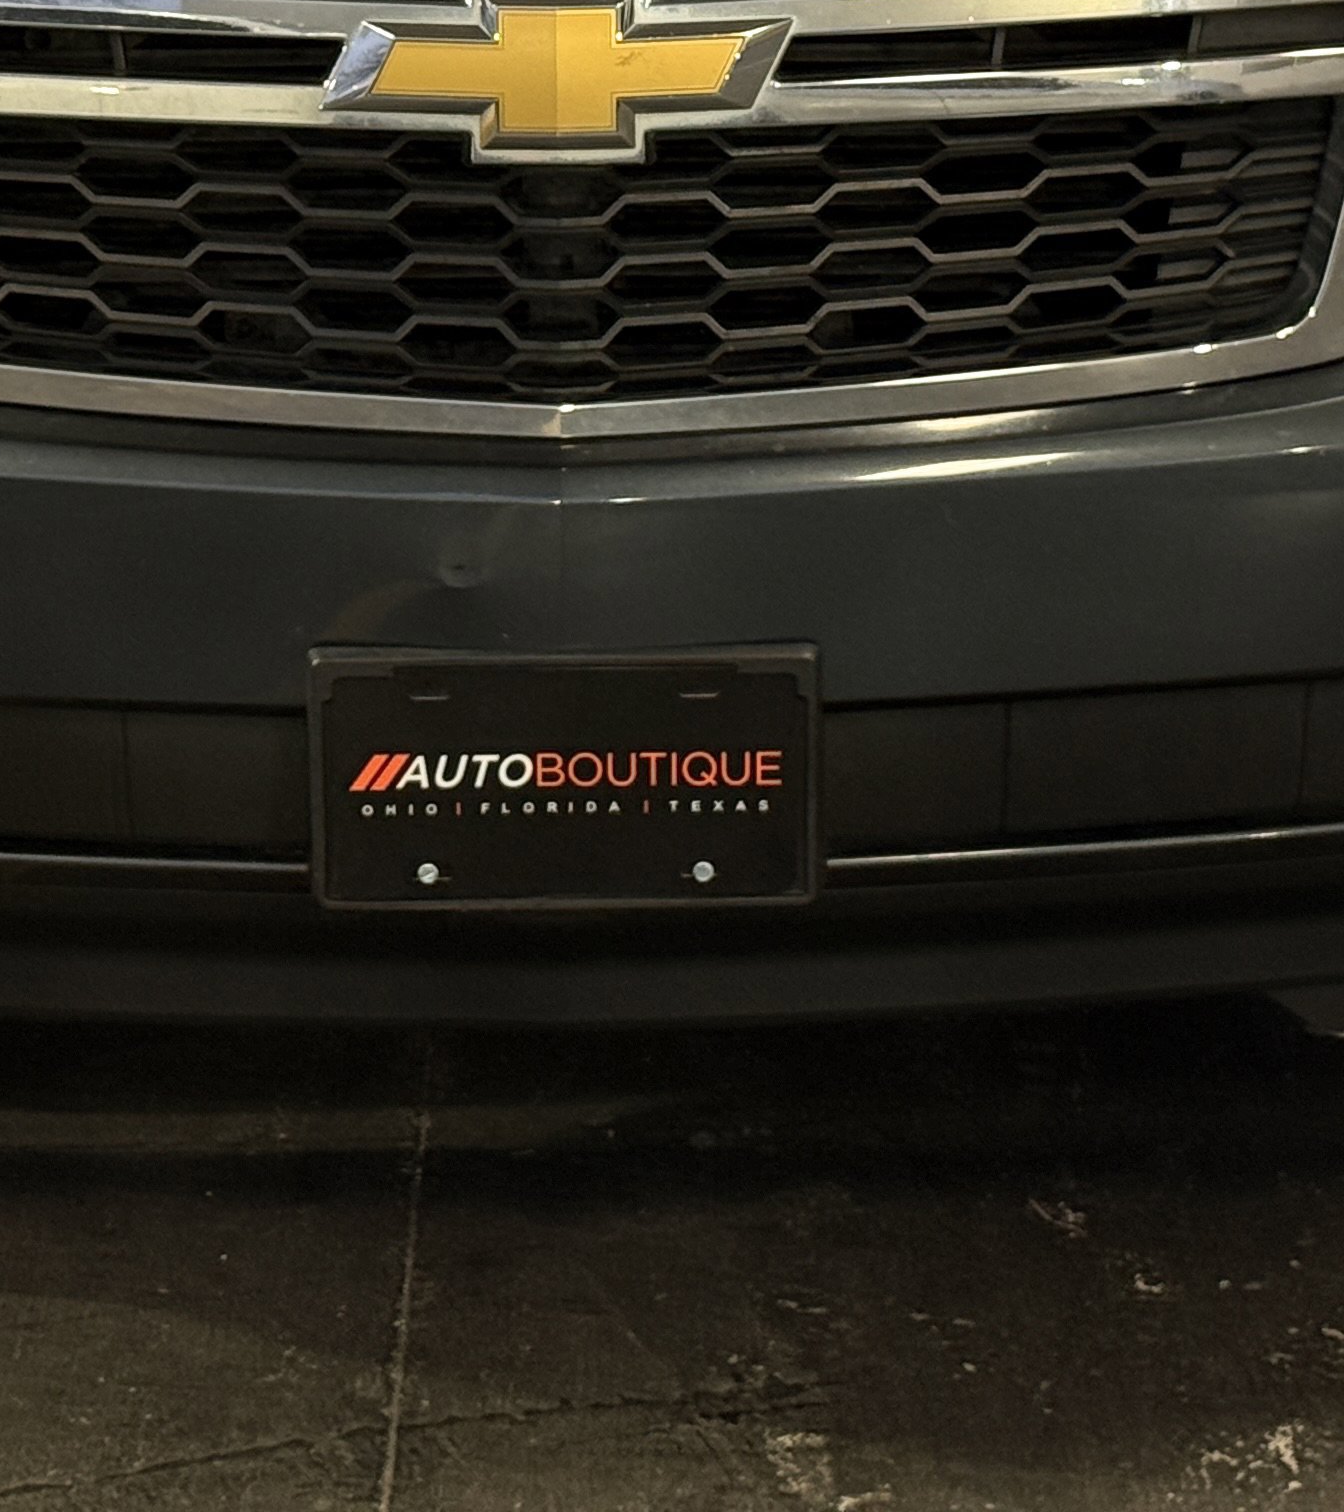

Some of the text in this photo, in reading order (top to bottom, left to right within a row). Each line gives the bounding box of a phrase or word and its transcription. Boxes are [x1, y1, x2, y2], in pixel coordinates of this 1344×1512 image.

[361, 799, 769, 817] OHIO FLORIDA TEXAS
